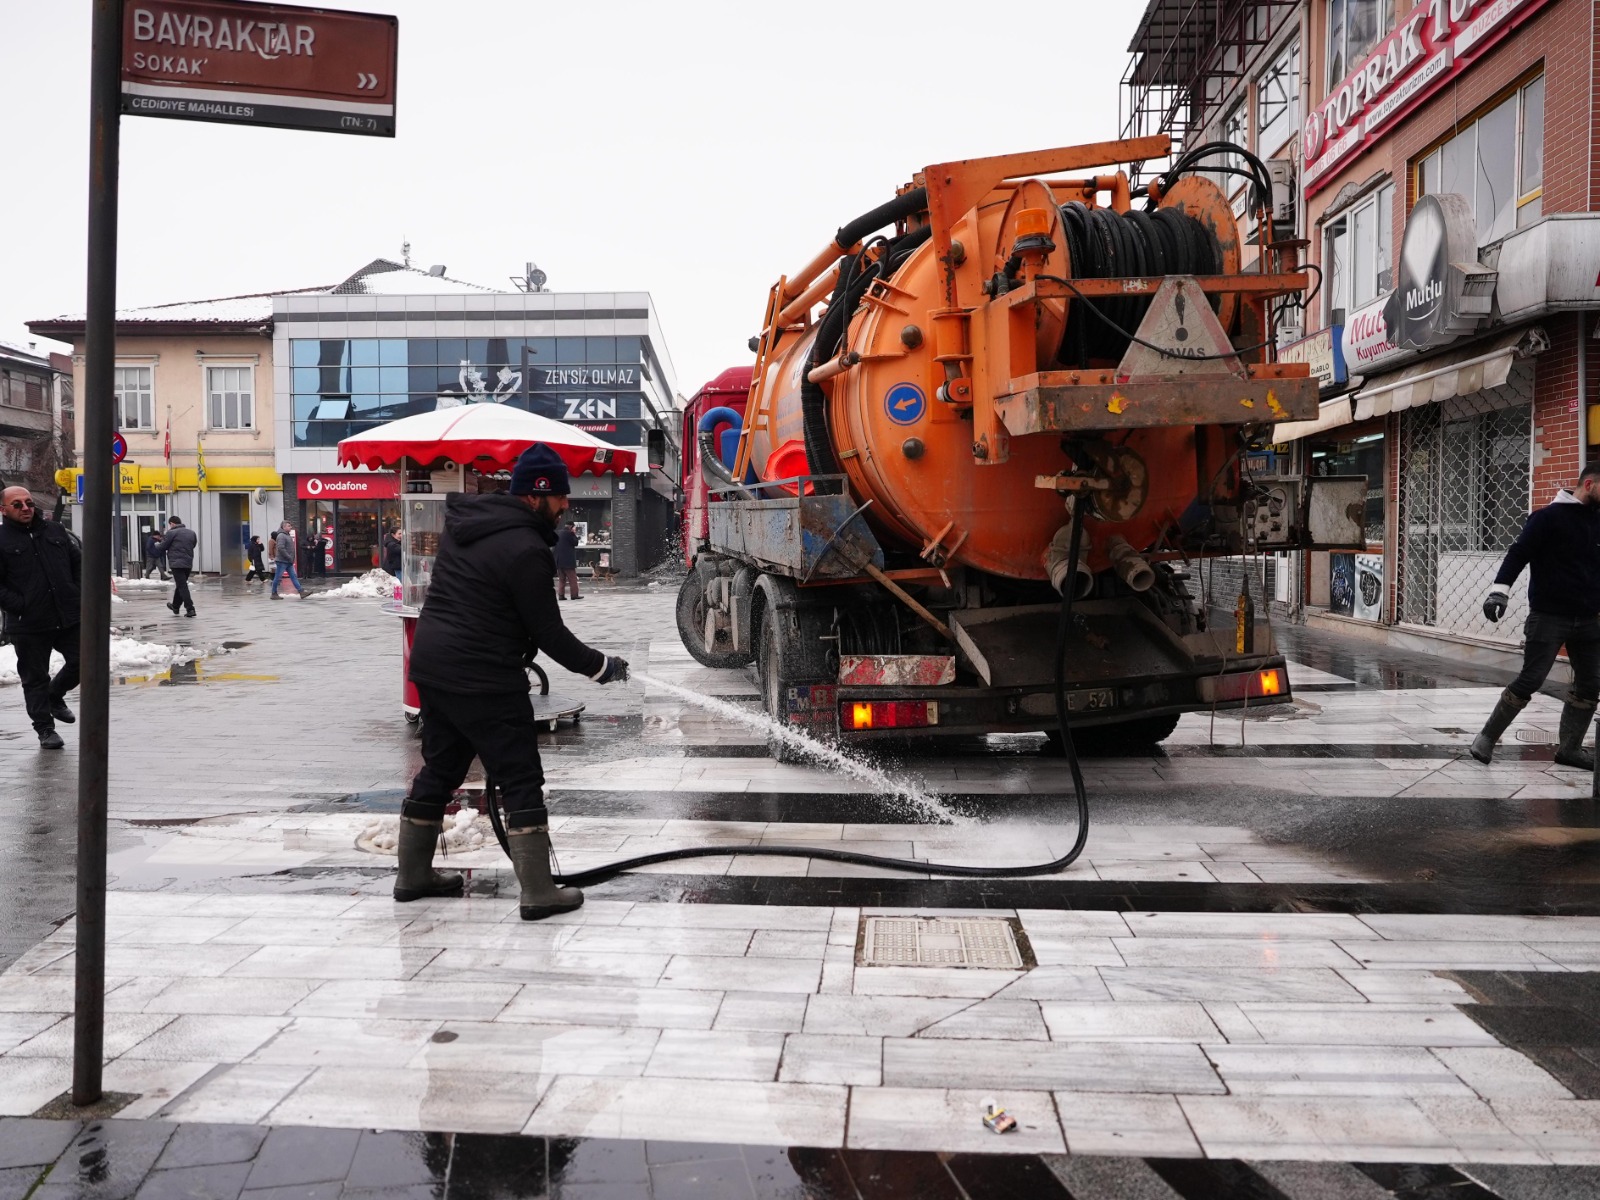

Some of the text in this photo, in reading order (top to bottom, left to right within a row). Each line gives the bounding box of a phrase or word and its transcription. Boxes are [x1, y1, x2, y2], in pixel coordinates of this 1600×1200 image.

[133, 8, 316, 57] BAYRAKTAR
[133, 52, 203, 75] SOKAK
[1324, 13, 1424, 140] TOPRAK
[1367, 56, 1442, 126] www.toprakturizm.com
[367, 118, 377, 131] 7)
[1406, 279, 1443, 312] Mutlu
[592, 369, 634, 384] OLMAZ
[563, 398, 616, 419] ZEN
[122, 475, 134, 484] Ptt
[324, 481, 368, 490] vodafone
[1089, 691, 1114, 708] 521
